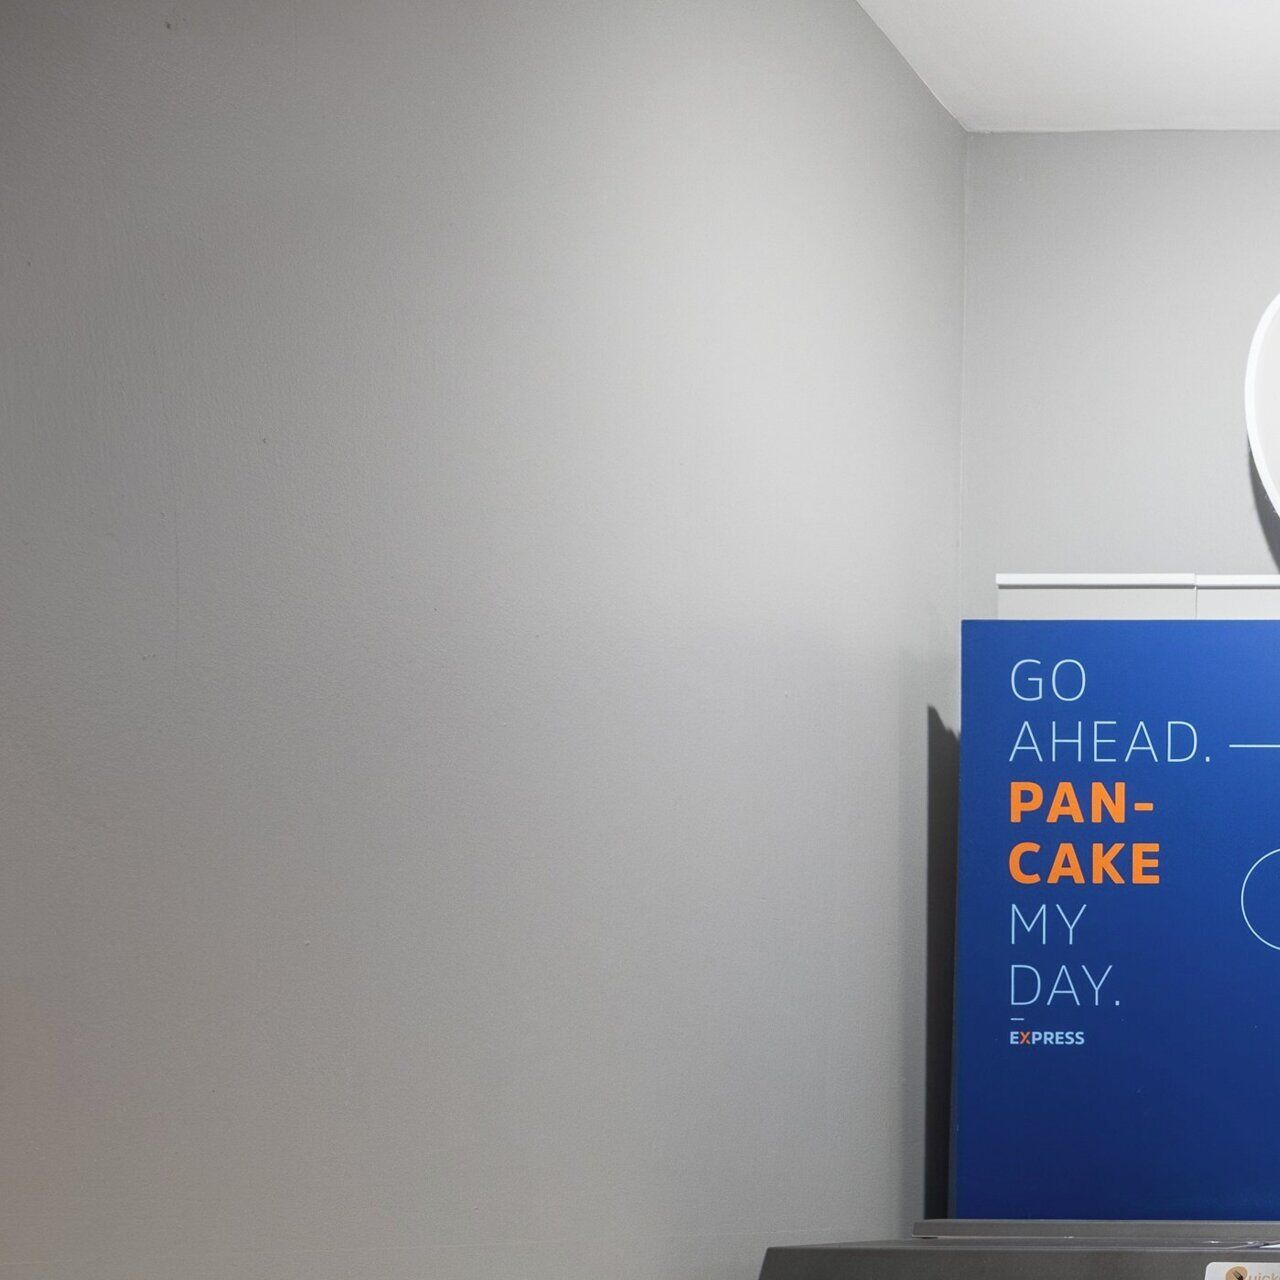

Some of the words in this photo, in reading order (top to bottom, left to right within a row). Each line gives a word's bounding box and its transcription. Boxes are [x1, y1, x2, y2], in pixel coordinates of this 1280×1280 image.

[1011, 659, 1085, 701] GO
[1009, 721, 1210, 762] AHEAD.
[1011, 782, 1153, 823] PAN-
[1009, 842, 1159, 884] CAKE
[1012, 904, 1086, 944] MY
[1011, 965, 1119, 1005] DAY.
[1010, 1032, 1084, 1044] EXPRESS
